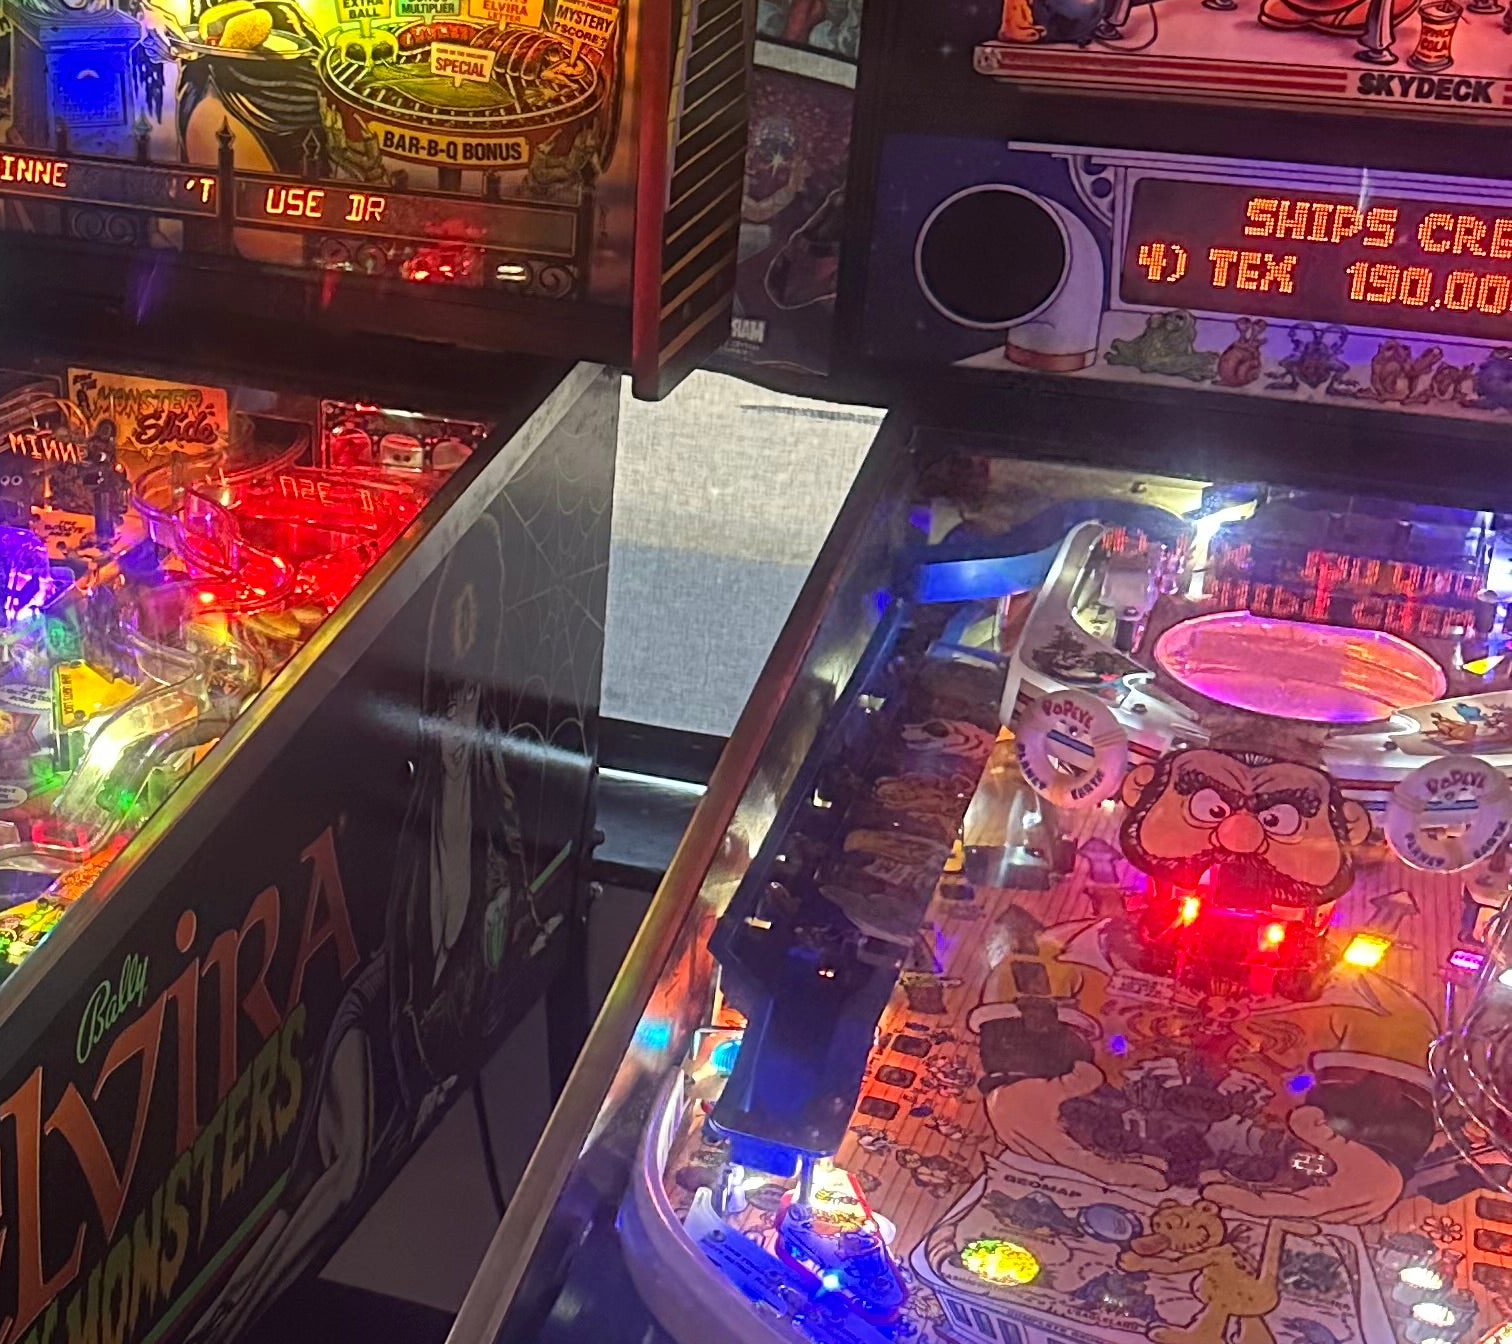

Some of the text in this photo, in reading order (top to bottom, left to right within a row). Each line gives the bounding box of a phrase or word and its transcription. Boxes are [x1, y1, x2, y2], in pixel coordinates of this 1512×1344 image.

[348, 8, 381, 20] BALL
[401, 2, 456, 14] MULTIPLIER
[482, 0, 529, 17] ELVIRA
[556, 4, 614, 34] MYSTERY
[1420, 37, 1450, 53] COLA
[434, 56, 487, 79] SPECIAL
[1356, 72, 1496, 104] SKYDECK
[382, 130, 523, 162] BAR-B-Q BONUS
[264, 186, 325, 218] USE
[344, 193, 387, 222] DR
[1243, 197, 1398, 249] SHIPS
[1137, 241, 1512, 316] 4) TEX 190,00
[95, 385, 203, 420] MONSTER
[133, 408, 220, 446] Slide
[1041, 698, 1094, 730] POPEYE
[76, 950, 151, 1065] Bally
[1003, 1173, 1083, 1200] GEOMAP
